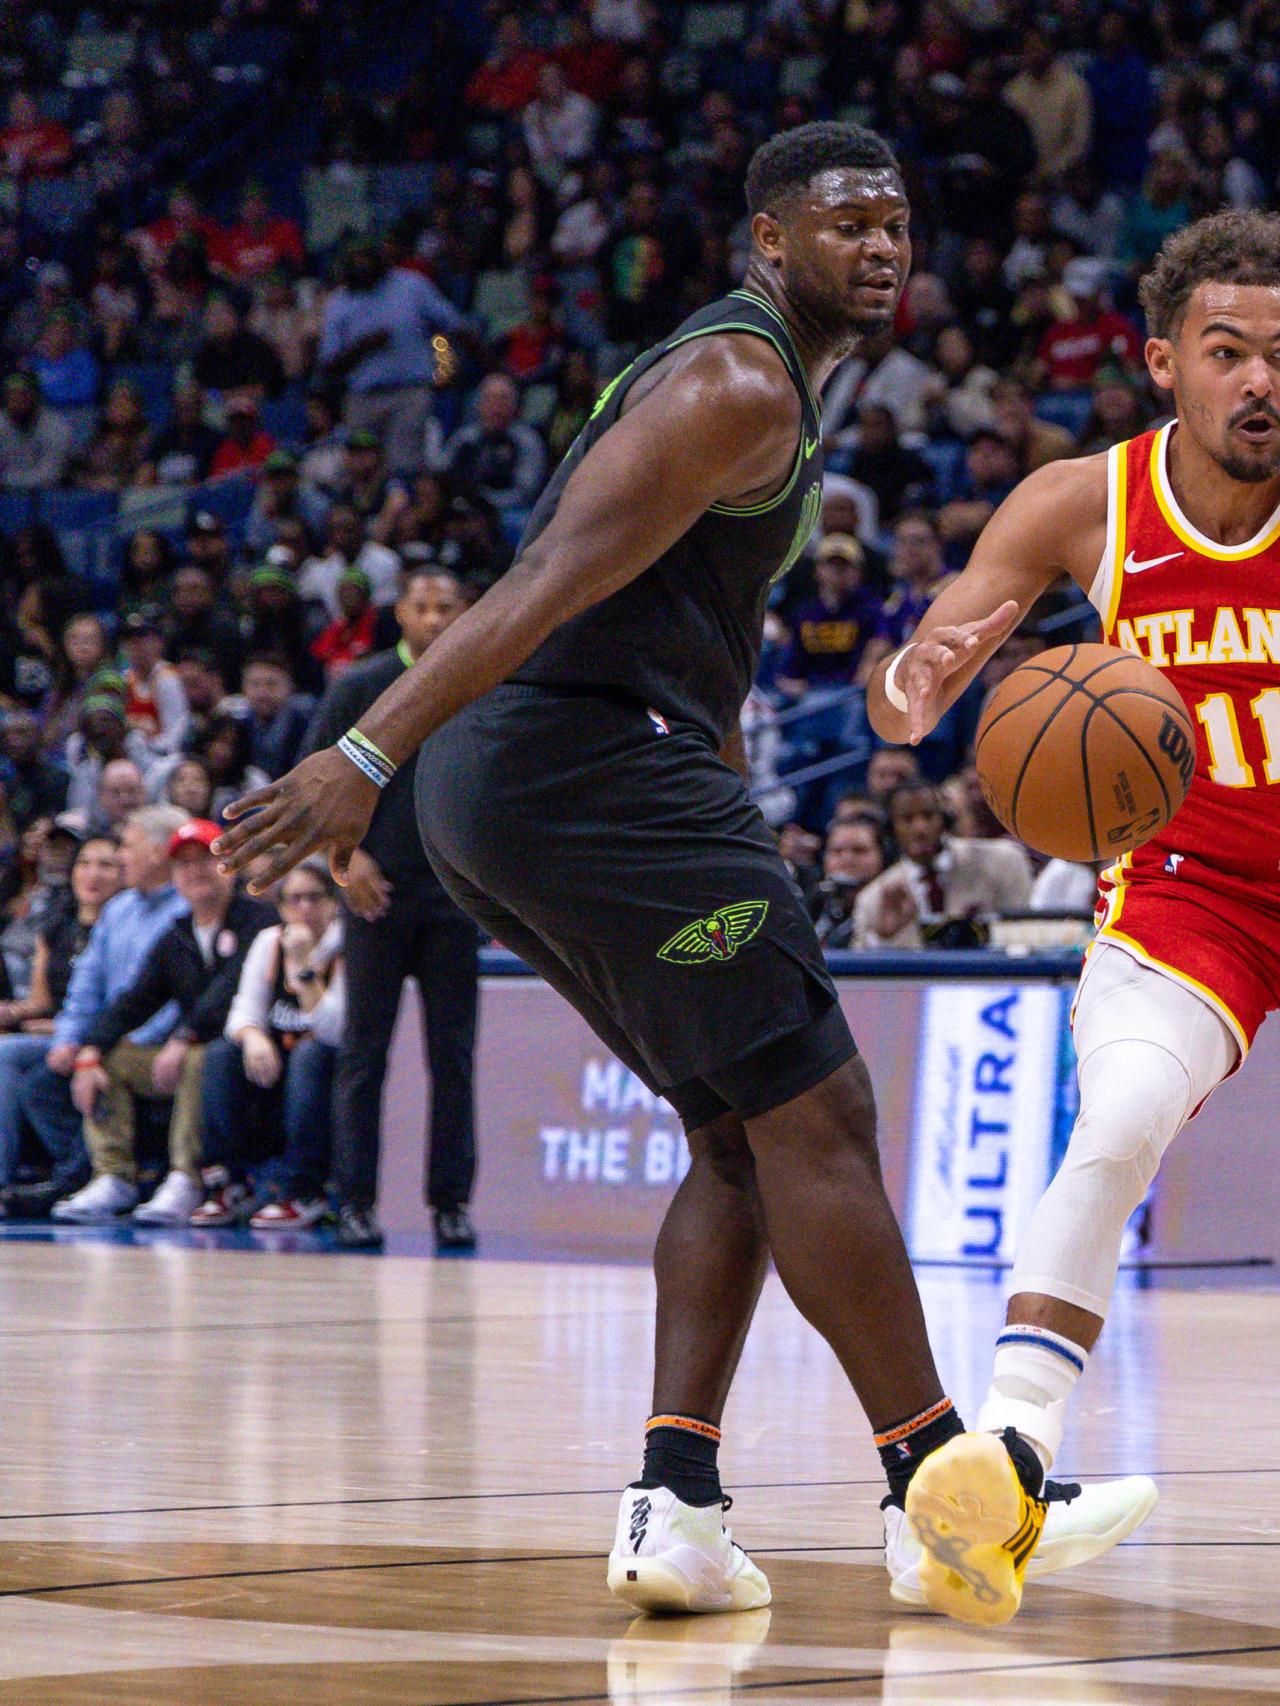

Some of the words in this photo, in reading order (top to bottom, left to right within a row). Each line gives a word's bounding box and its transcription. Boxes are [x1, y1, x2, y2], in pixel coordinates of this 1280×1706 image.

[583, 1060, 679, 1113] MA
[961, 993, 1019, 1255] ULTRA
[540, 1127, 629, 1182] THE
